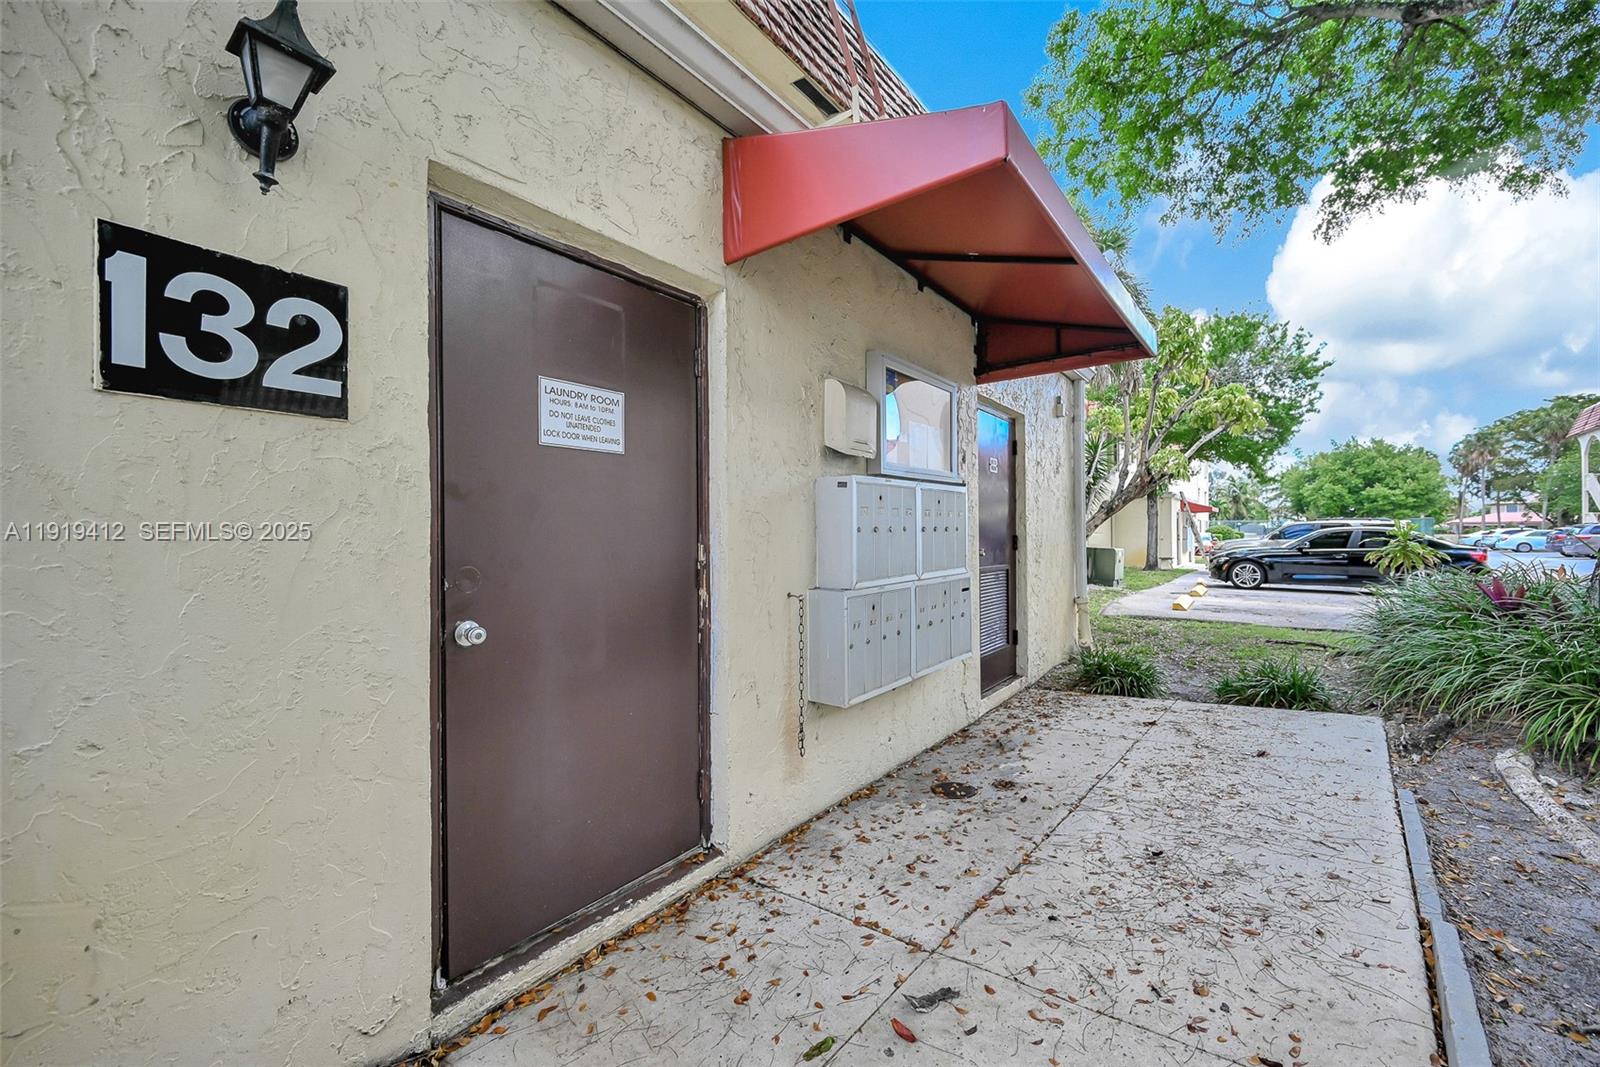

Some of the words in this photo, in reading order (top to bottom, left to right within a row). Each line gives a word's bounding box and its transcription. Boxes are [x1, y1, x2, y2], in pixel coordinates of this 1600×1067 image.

[105, 250, 343, 398] 132
[545, 385, 588, 401] LAUNDRY
[590, 394, 620, 408] ROOM
[574, 402, 589, 410] 8AM
[590, 404, 597, 412] to
[549, 409, 560, 418] DO
[561, 411, 574, 420] NOT
[575, 414, 591, 424] LEAVE
[592, 416, 616, 427] CLOTHES
[543, 429, 560, 438] LOCK
[561, 431, 580, 441] DOOR
[581, 434, 598, 443] WHEN
[599, 436, 621, 446] LEAVING
